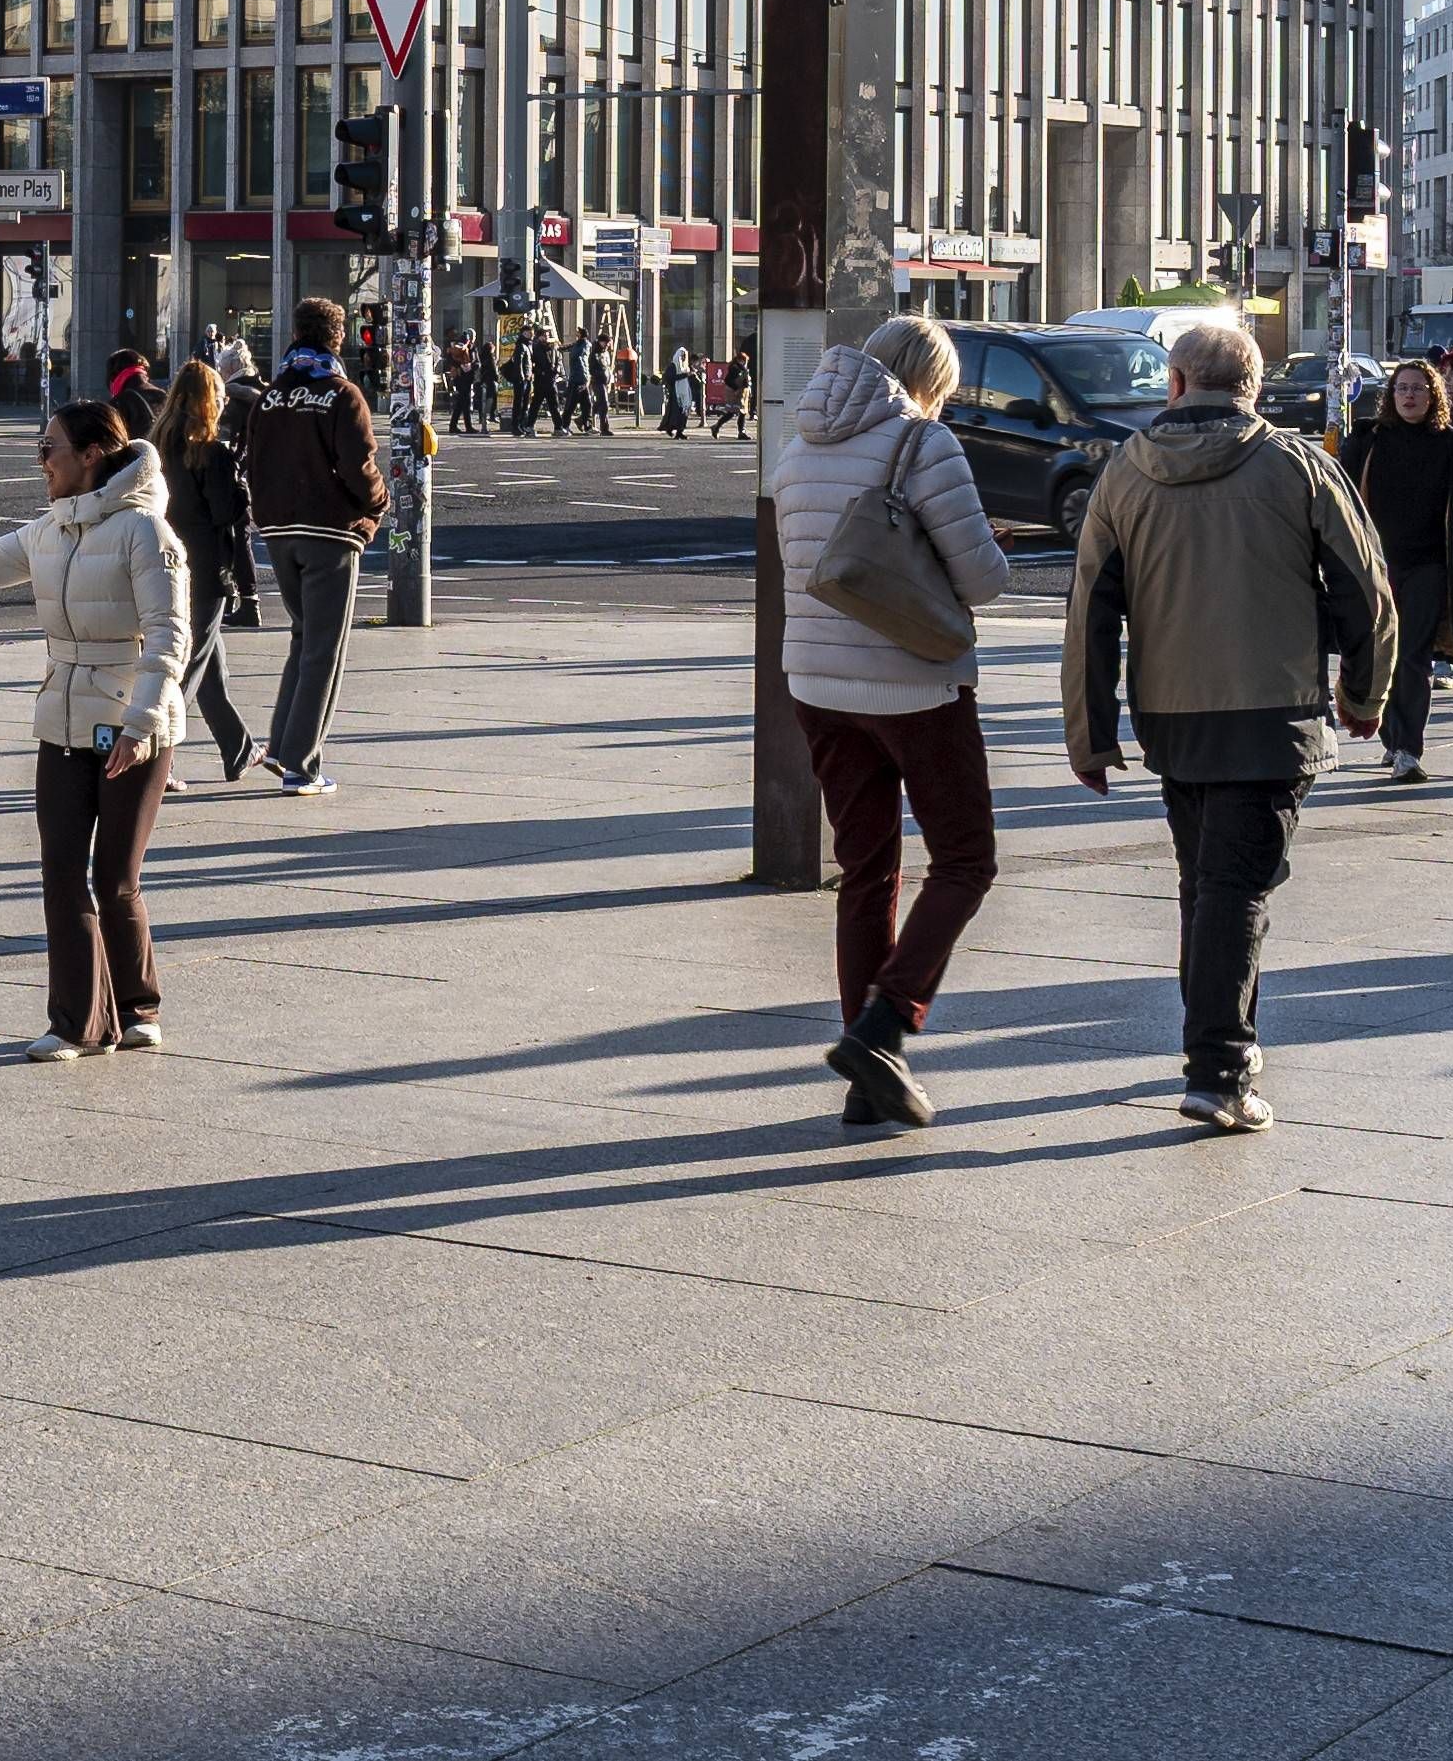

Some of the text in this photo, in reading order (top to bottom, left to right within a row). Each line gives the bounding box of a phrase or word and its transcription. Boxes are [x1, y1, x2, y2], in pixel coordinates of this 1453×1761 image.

[23, 180, 52, 201] Platz
[261, 386, 337, 411] St. Pauli
